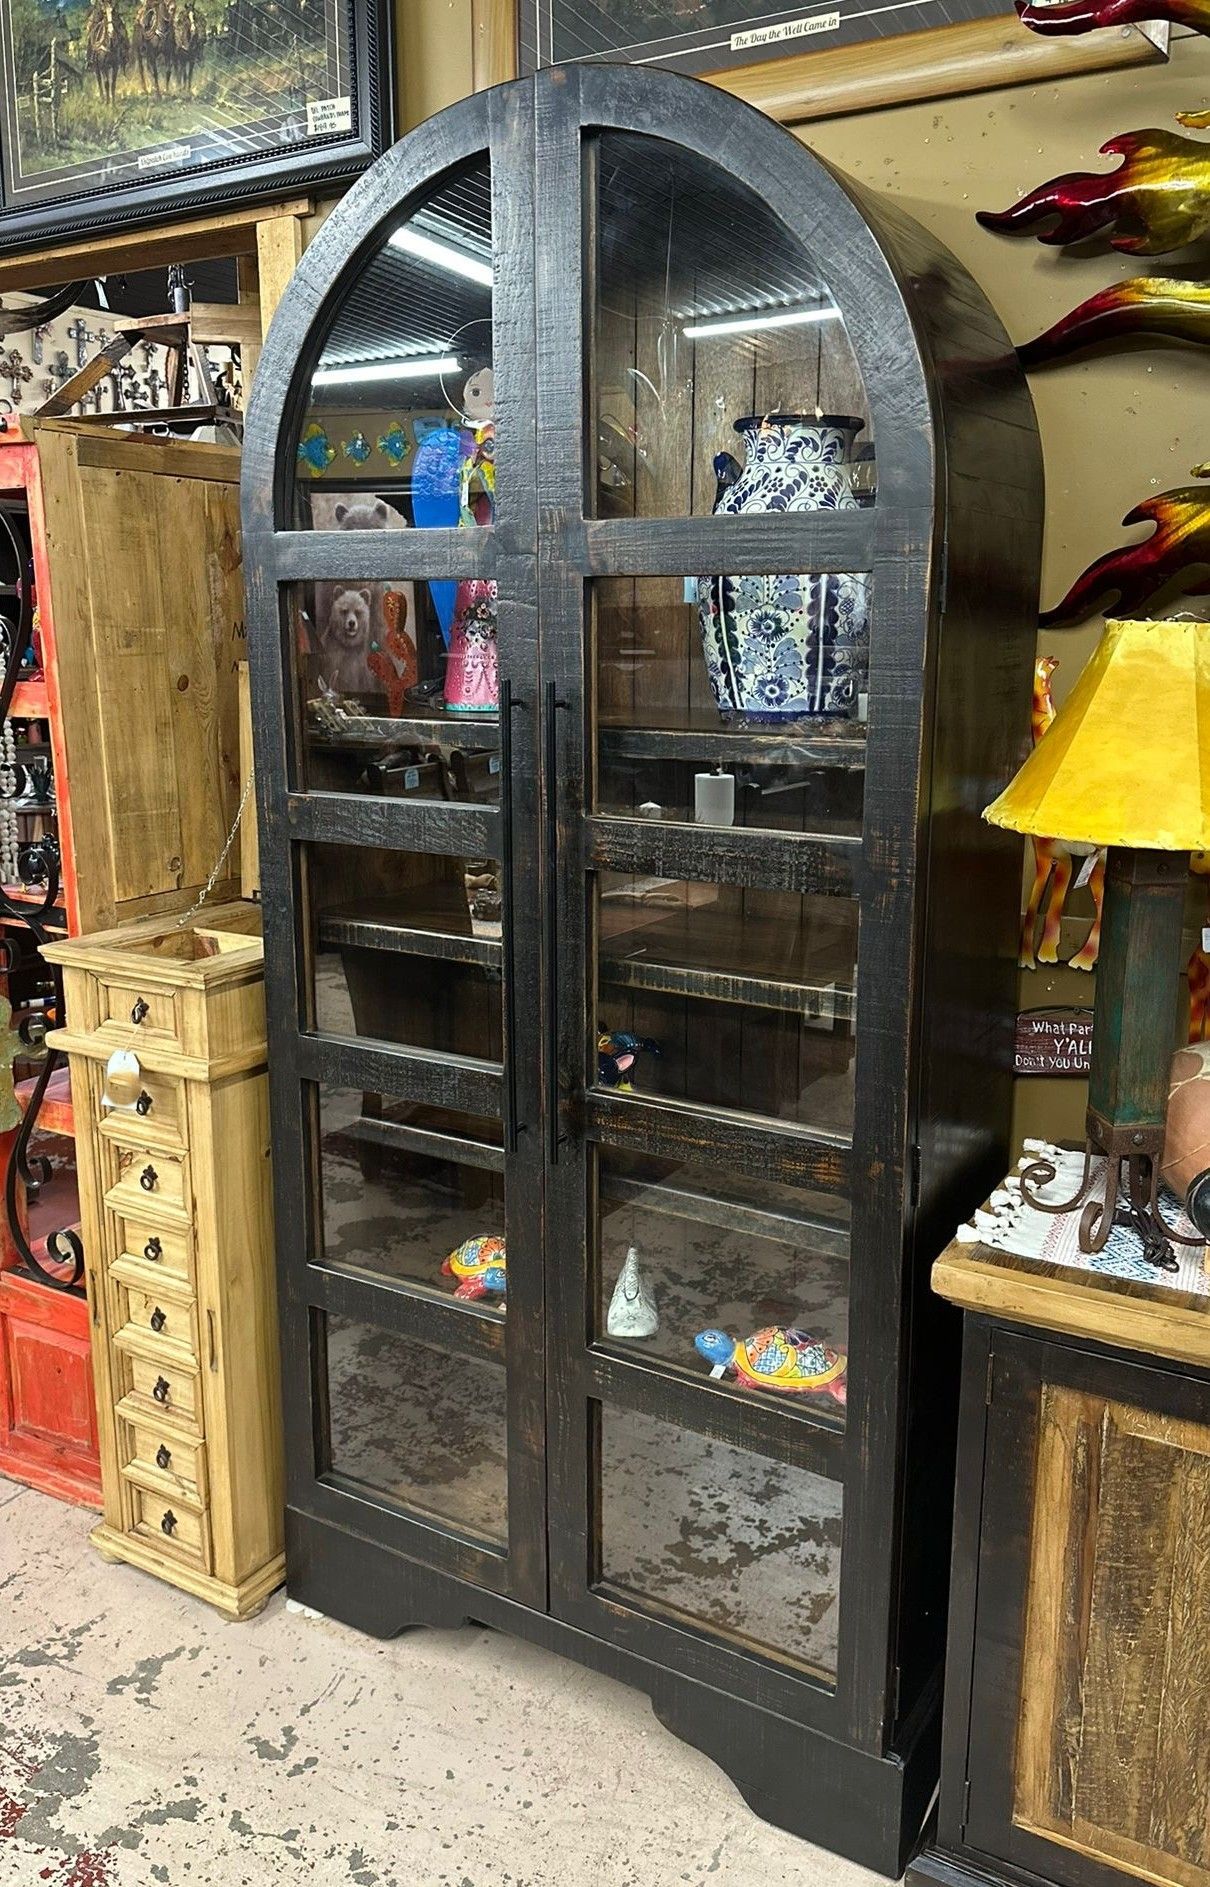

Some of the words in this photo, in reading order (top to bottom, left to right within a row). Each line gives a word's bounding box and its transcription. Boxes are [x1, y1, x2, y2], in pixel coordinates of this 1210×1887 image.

[735, 36, 748, 47] The
[750, 32, 767, 43] Day
[769, 30, 781, 40] the
[783, 24, 802, 36] Well
[804, 21, 827, 32] Came
[828, 17, 837, 26] in
[1032, 1021, 1066, 1035] What
[1015, 1054, 1045, 1067] Don't
[1074, 1056, 1091, 1070] Un
